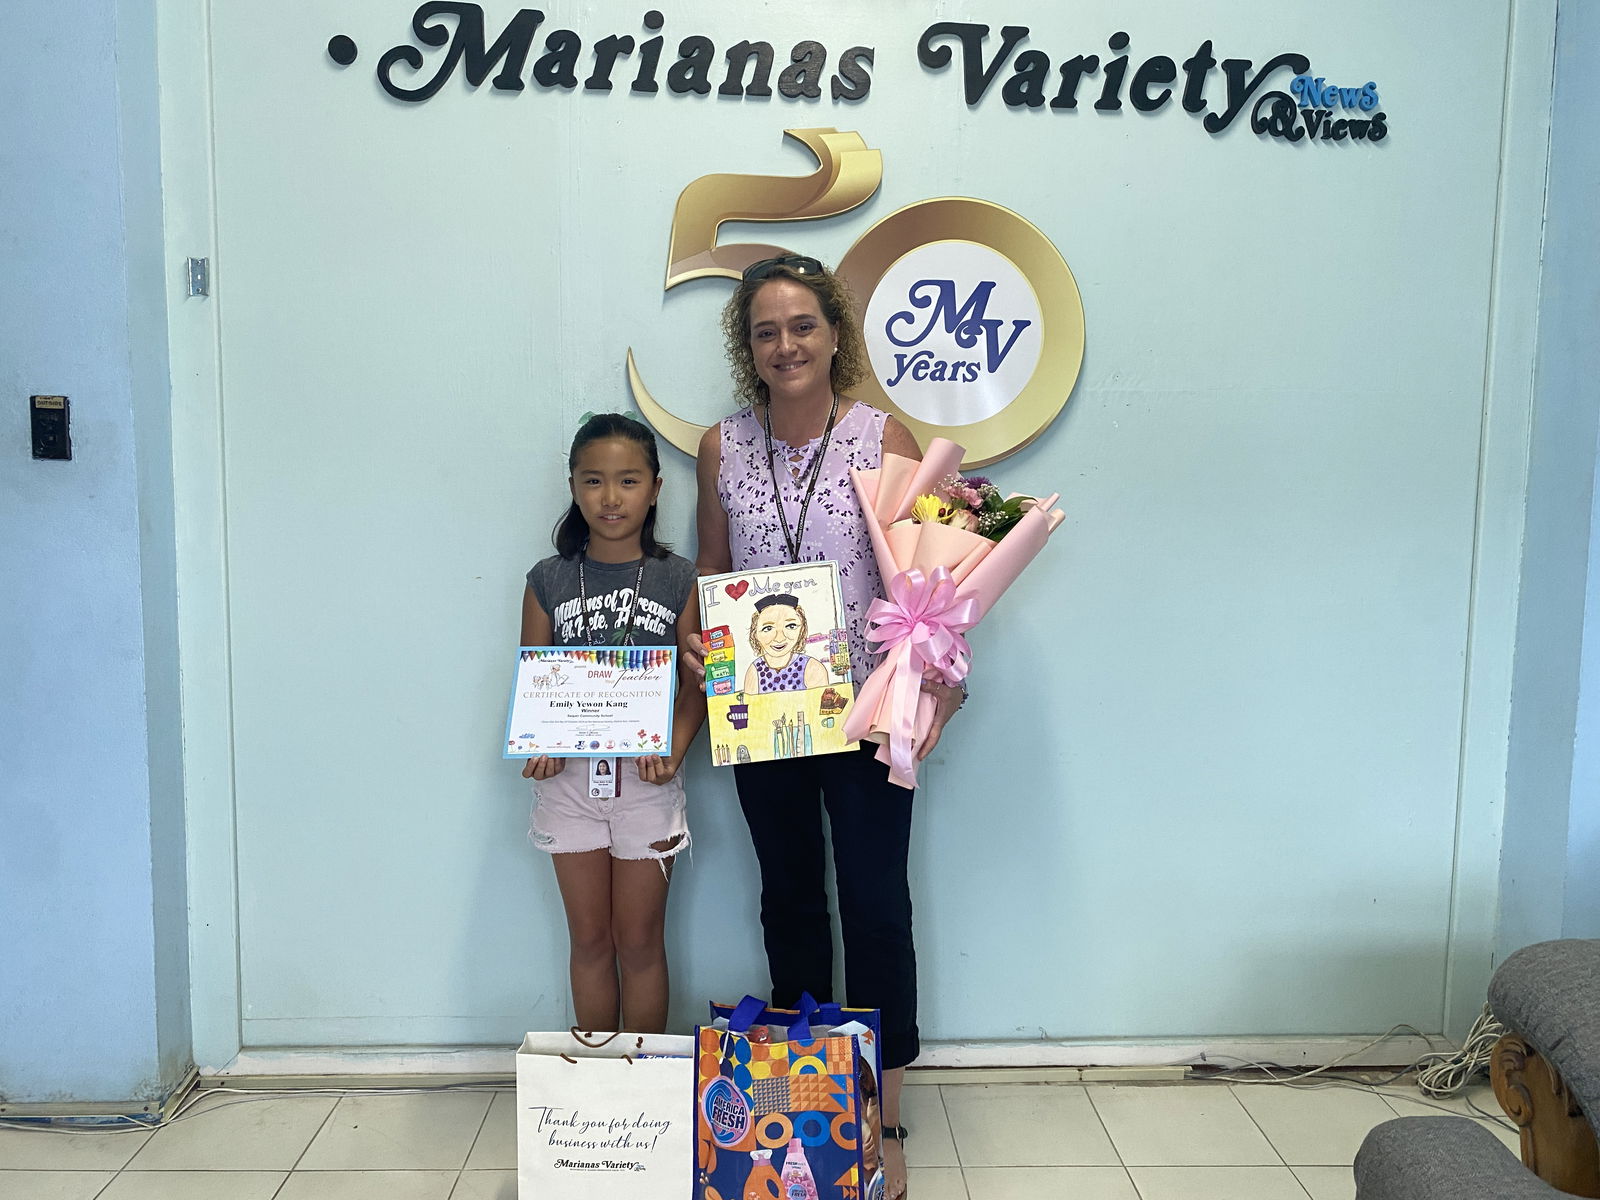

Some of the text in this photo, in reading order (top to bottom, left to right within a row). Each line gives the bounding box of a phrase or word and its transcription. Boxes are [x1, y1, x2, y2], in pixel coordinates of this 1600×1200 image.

[377, 0, 1311, 133] Marianas Variety
[1290, 75, 1379, 111] News
[885, 279, 1031, 373] MV
[886, 350, 981, 387] years
[604, 589, 619, 612] of
[705, 576, 818, 607] I Megan
[614, 607, 667, 637] Flrida
[587, 667, 663, 689] DRAW Teacher
[523, 691, 581, 699] CERTIFICATE
[598, 690, 662, 698] RECOGNITION
[550, 701, 574, 709] Emily
[605, 700, 628, 708] Kang
[712, 1105, 746, 1129] FRESH
[714, 1096, 746, 1116] AMERICA
[528, 1106, 671, 1135] Thank you for doing
[548, 1129, 599, 1150] business
[600, 1131, 634, 1149] with
[554, 1158, 600, 1168] Marianas
[601, 1160, 640, 1170] Variety
